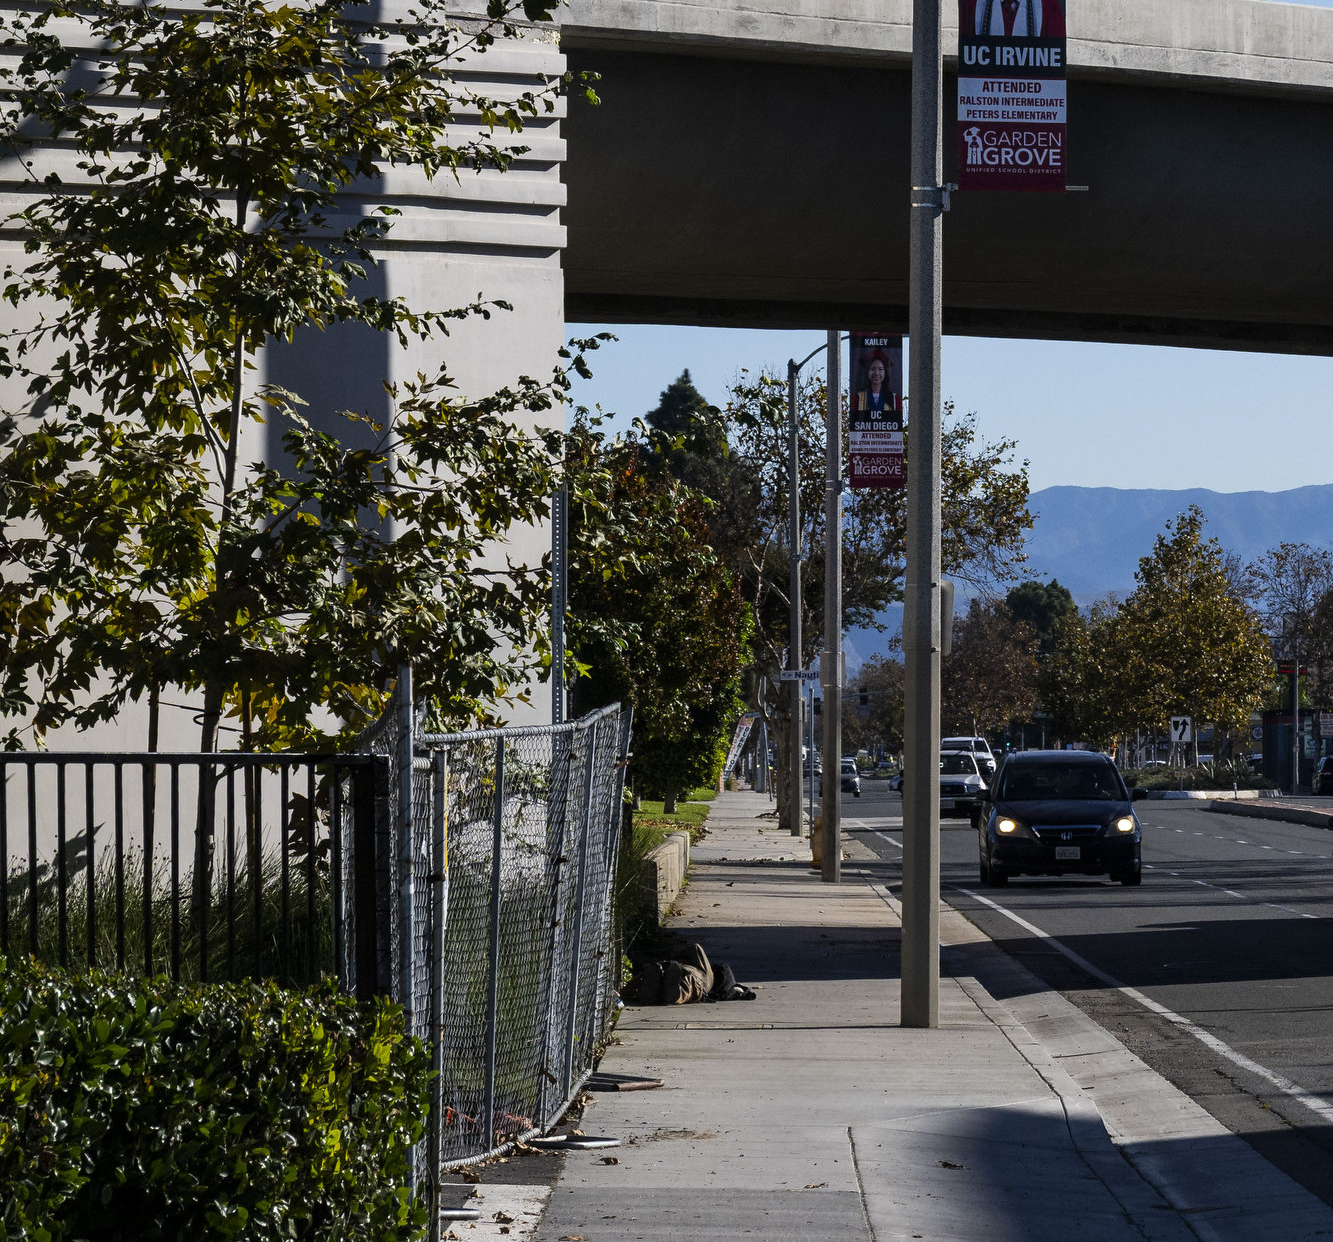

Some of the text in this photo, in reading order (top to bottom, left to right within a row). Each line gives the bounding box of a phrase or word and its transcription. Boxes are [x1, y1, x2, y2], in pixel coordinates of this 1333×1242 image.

[963, 45, 1062, 67] UC IRVINE
[982, 81, 1042, 94] ATTENDED
[960, 96, 1065, 108] RALSTON INTERMEDIATE
[967, 109, 1058, 120] PETERS ELEMENTARY
[983, 130, 1062, 147] GARDEN
[982, 147, 1062, 166] GROVE
[864, 338, 888, 346] KAILEY
[870, 410, 882, 420] UC
[855, 422, 899, 431] SAN DIEGO
[862, 457, 902, 465] GARDEN
[862, 465, 902, 475] GROVE
